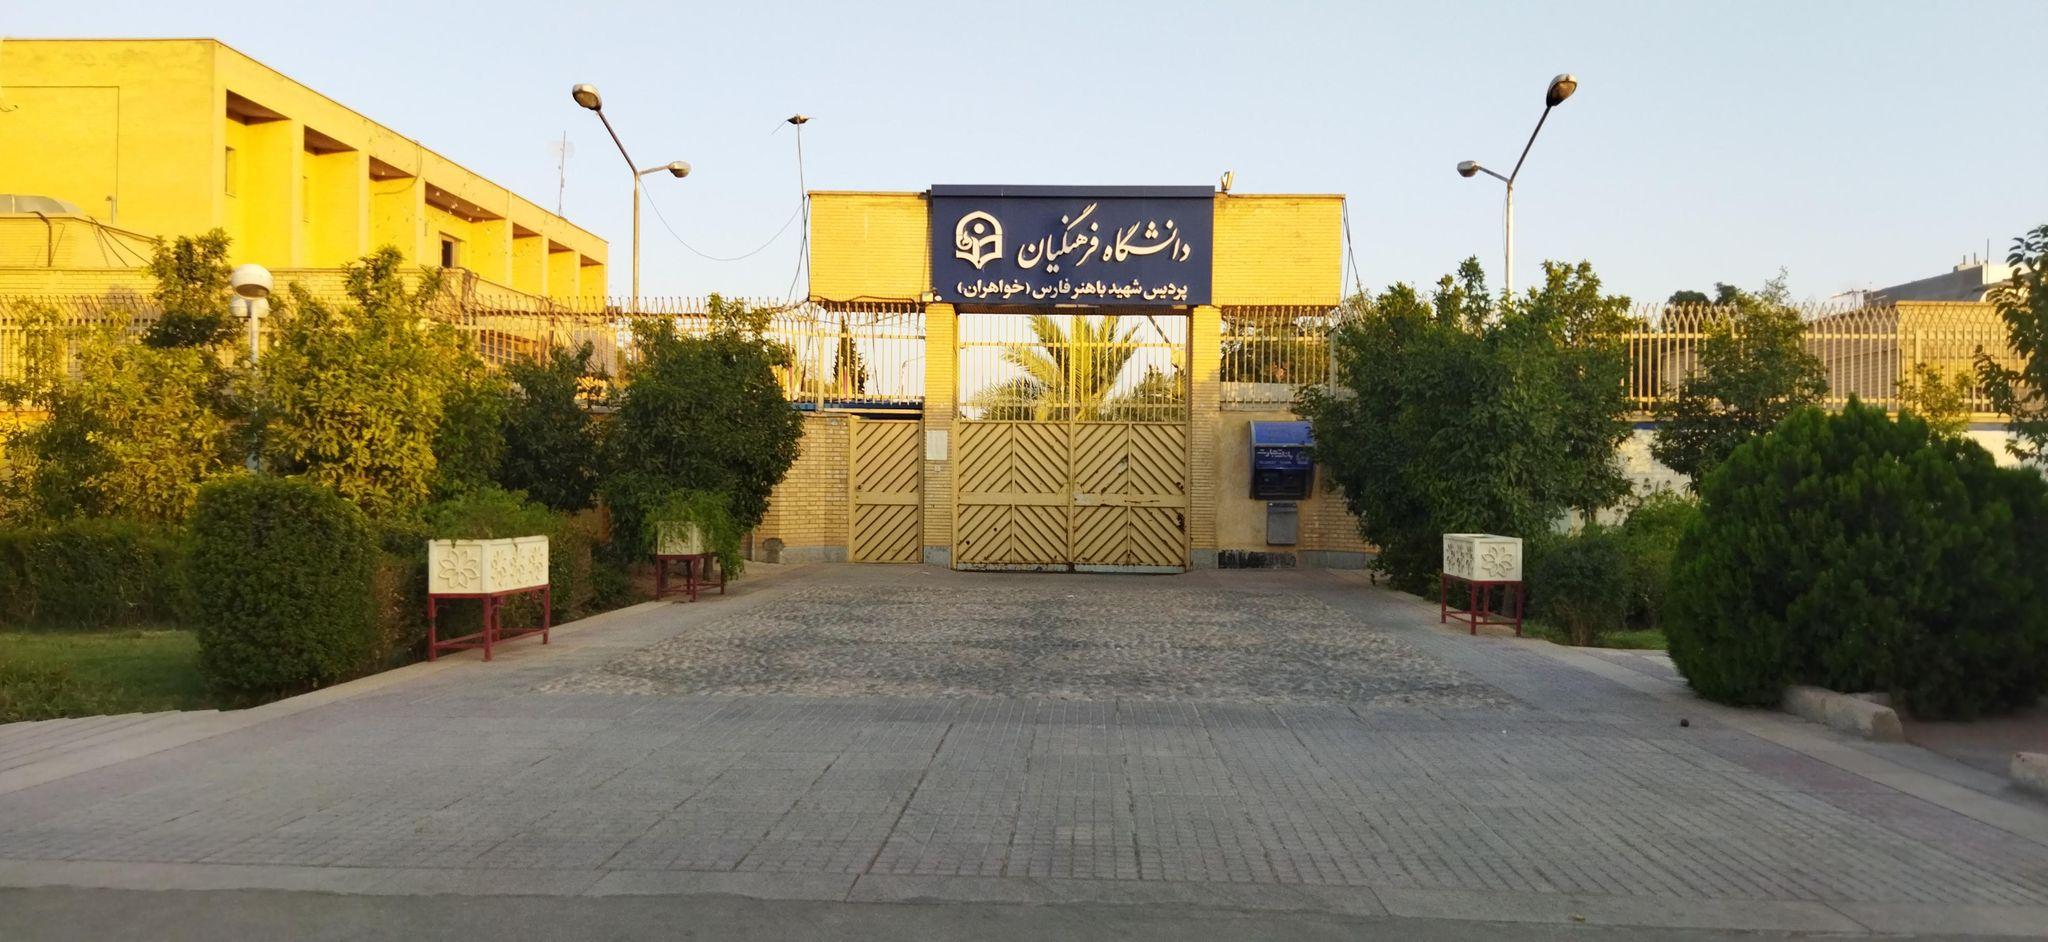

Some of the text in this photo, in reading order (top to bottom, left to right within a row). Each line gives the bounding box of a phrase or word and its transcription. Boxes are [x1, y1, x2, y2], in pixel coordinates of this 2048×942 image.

[1017, 202, 1191, 274] دانشگاه فرهنگیان
[956, 277, 1189, 302] پردیس شهید باهنر فارس (خواهران)
